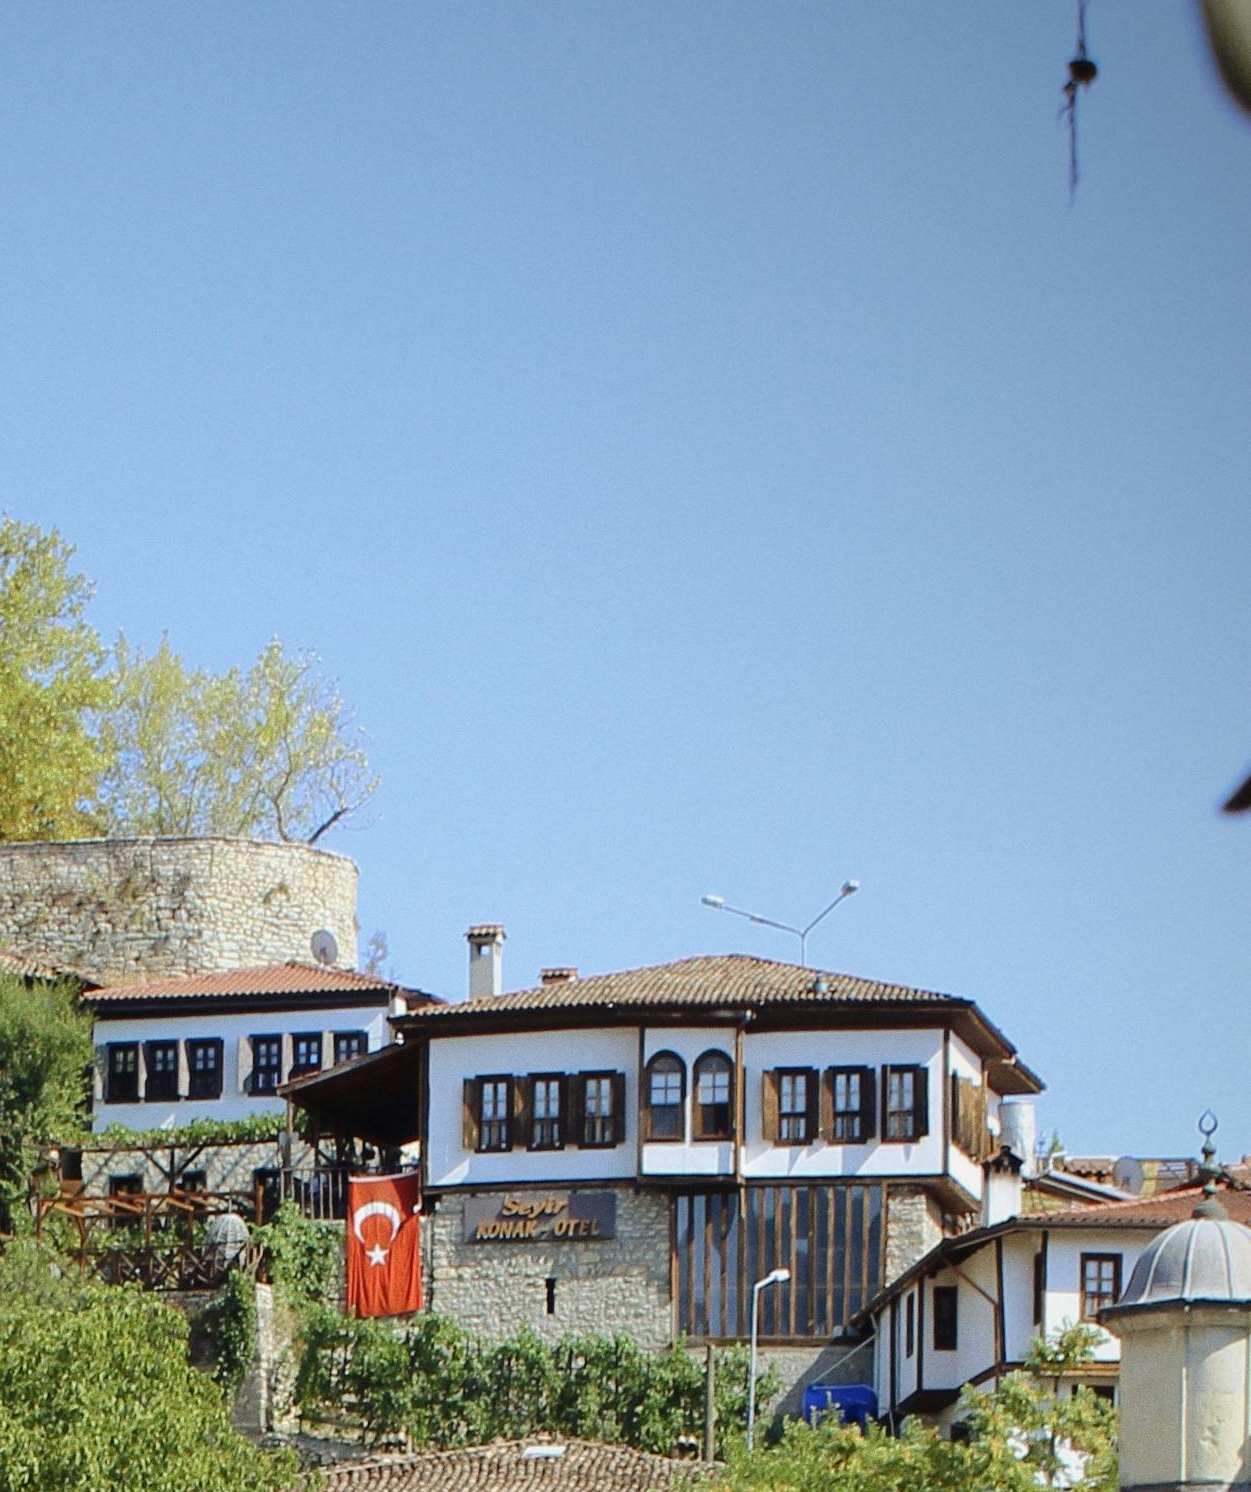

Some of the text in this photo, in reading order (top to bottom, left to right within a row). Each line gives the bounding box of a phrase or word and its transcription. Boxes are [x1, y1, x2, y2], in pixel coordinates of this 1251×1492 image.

[501, 1195, 568, 1219] Seyir
[476, 1220, 538, 1240] KONAK
[554, 1217, 602, 1237] OTEL
